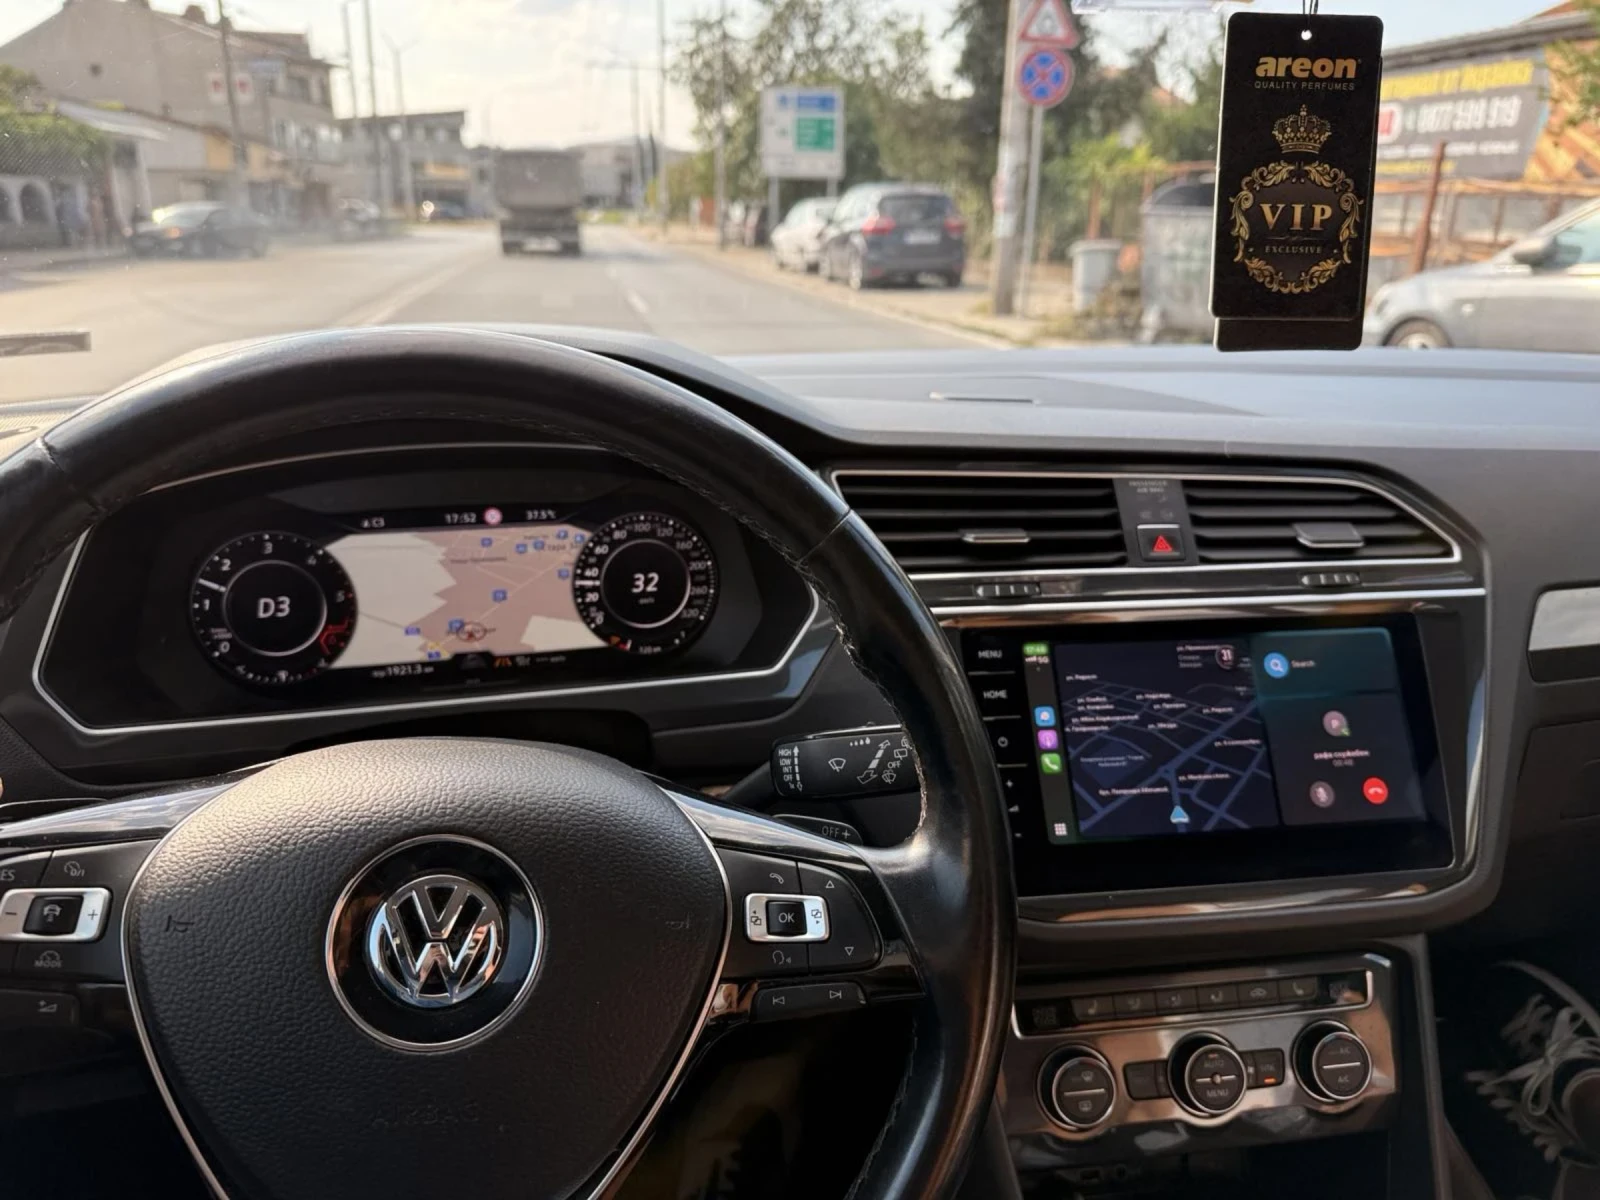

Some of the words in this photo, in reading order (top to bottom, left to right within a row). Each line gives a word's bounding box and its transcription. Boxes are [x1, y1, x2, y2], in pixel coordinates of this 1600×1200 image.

[1255, 56, 1357, 78] areon
[1254, 81, 1297, 90] QUALITY
[1301, 81, 1355, 91] PERFUMES
[1260, 203, 1332, 230] VIP
[1265, 245, 1322, 254] EXCLUSIVE
[634, 522, 651, 532] 100
[656, 527, 674, 537] 120
[612, 530, 627, 540] 80
[264, 542, 273, 554] 3
[594, 544, 609, 554] 60
[676, 540, 693, 550] 160
[221, 559, 231, 571] 2
[688, 562, 706, 570] 200
[584, 567, 599, 578] 40
[631, 572, 659, 593] 32
[584, 592, 599, 602] 20
[257, 596, 290, 619] D3
[220, 642, 230, 653] 0
[978, 650, 1002, 658] MENU
[983, 690, 1007, 699] HOME
[887, 760, 901, 769] OFF
[822, 826, 840, 838] OFF
[778, 912, 795, 924] OK
[1206, 1088, 1229, 1098] MENU
